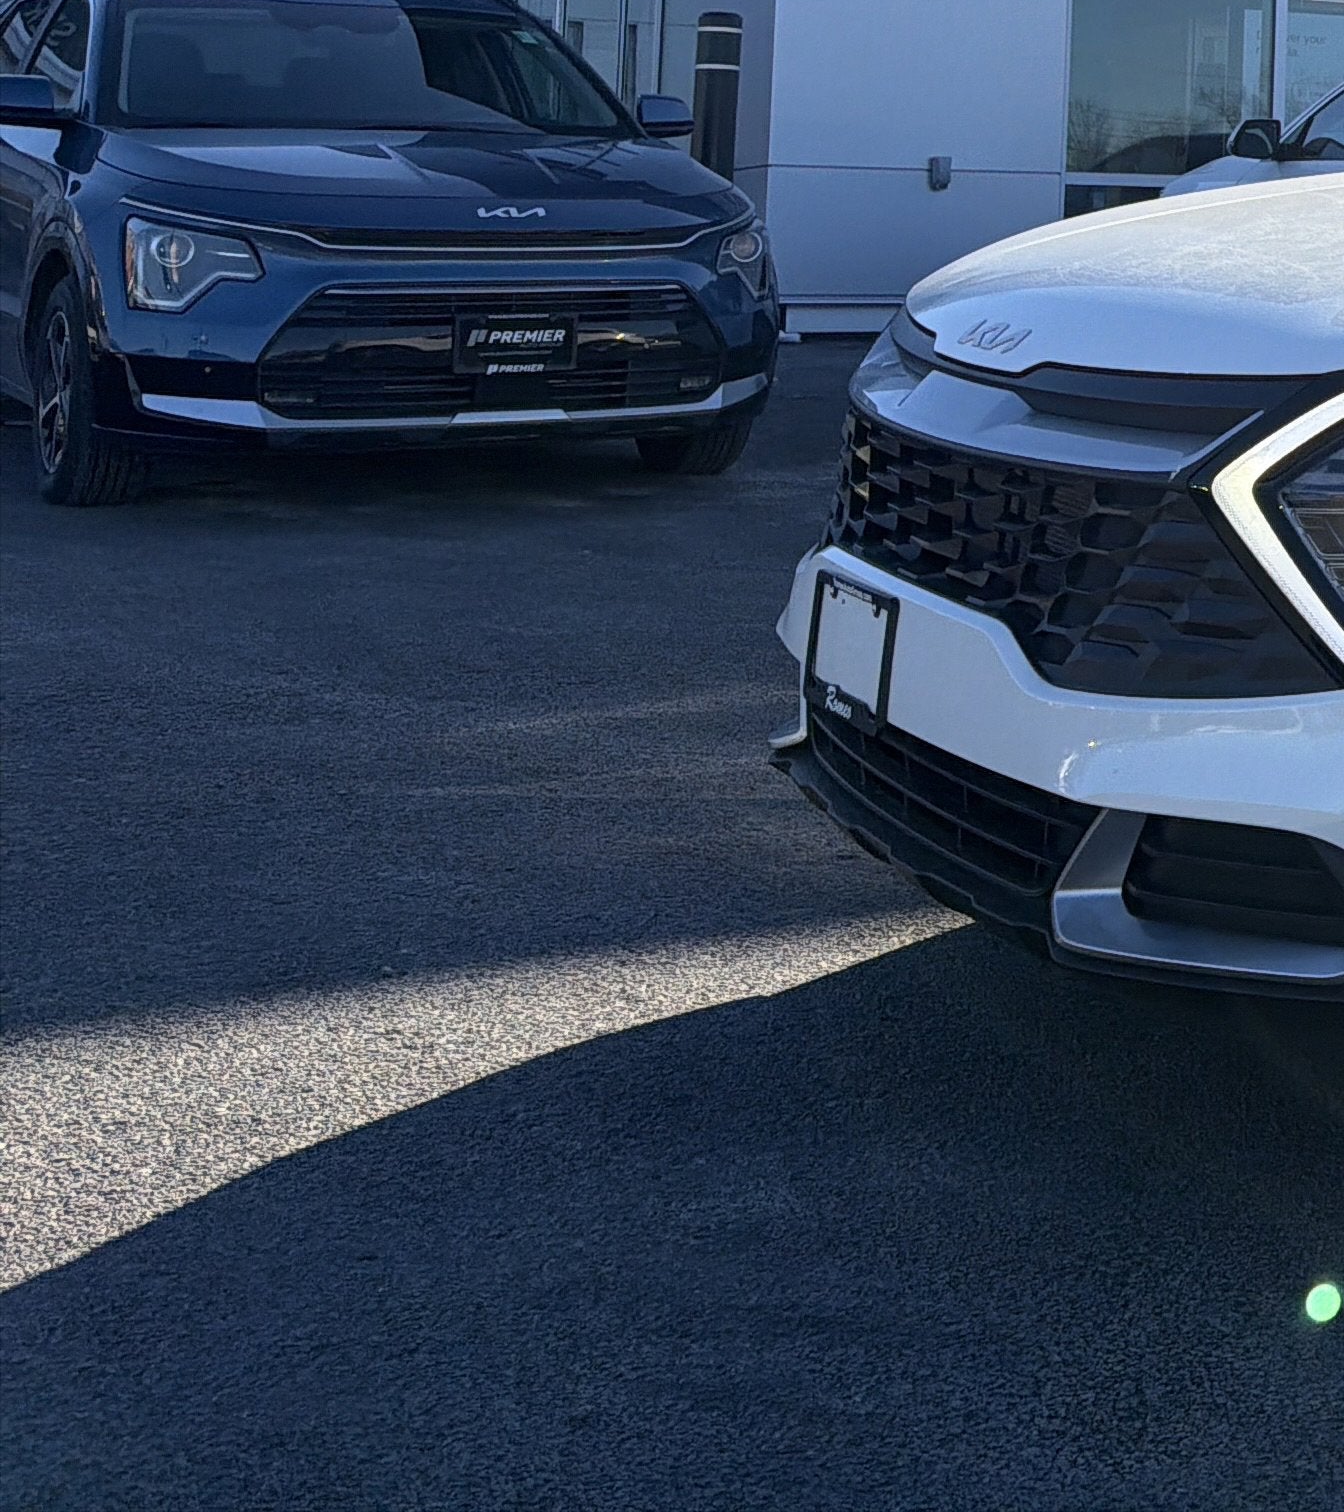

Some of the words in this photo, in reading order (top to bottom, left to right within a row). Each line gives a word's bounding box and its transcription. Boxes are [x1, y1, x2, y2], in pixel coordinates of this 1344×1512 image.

[477, 207, 546, 218] KIA
[488, 329, 566, 343] PREMIER
[958, 319, 1033, 355] KIA
[499, 364, 545, 373] PREMIER
